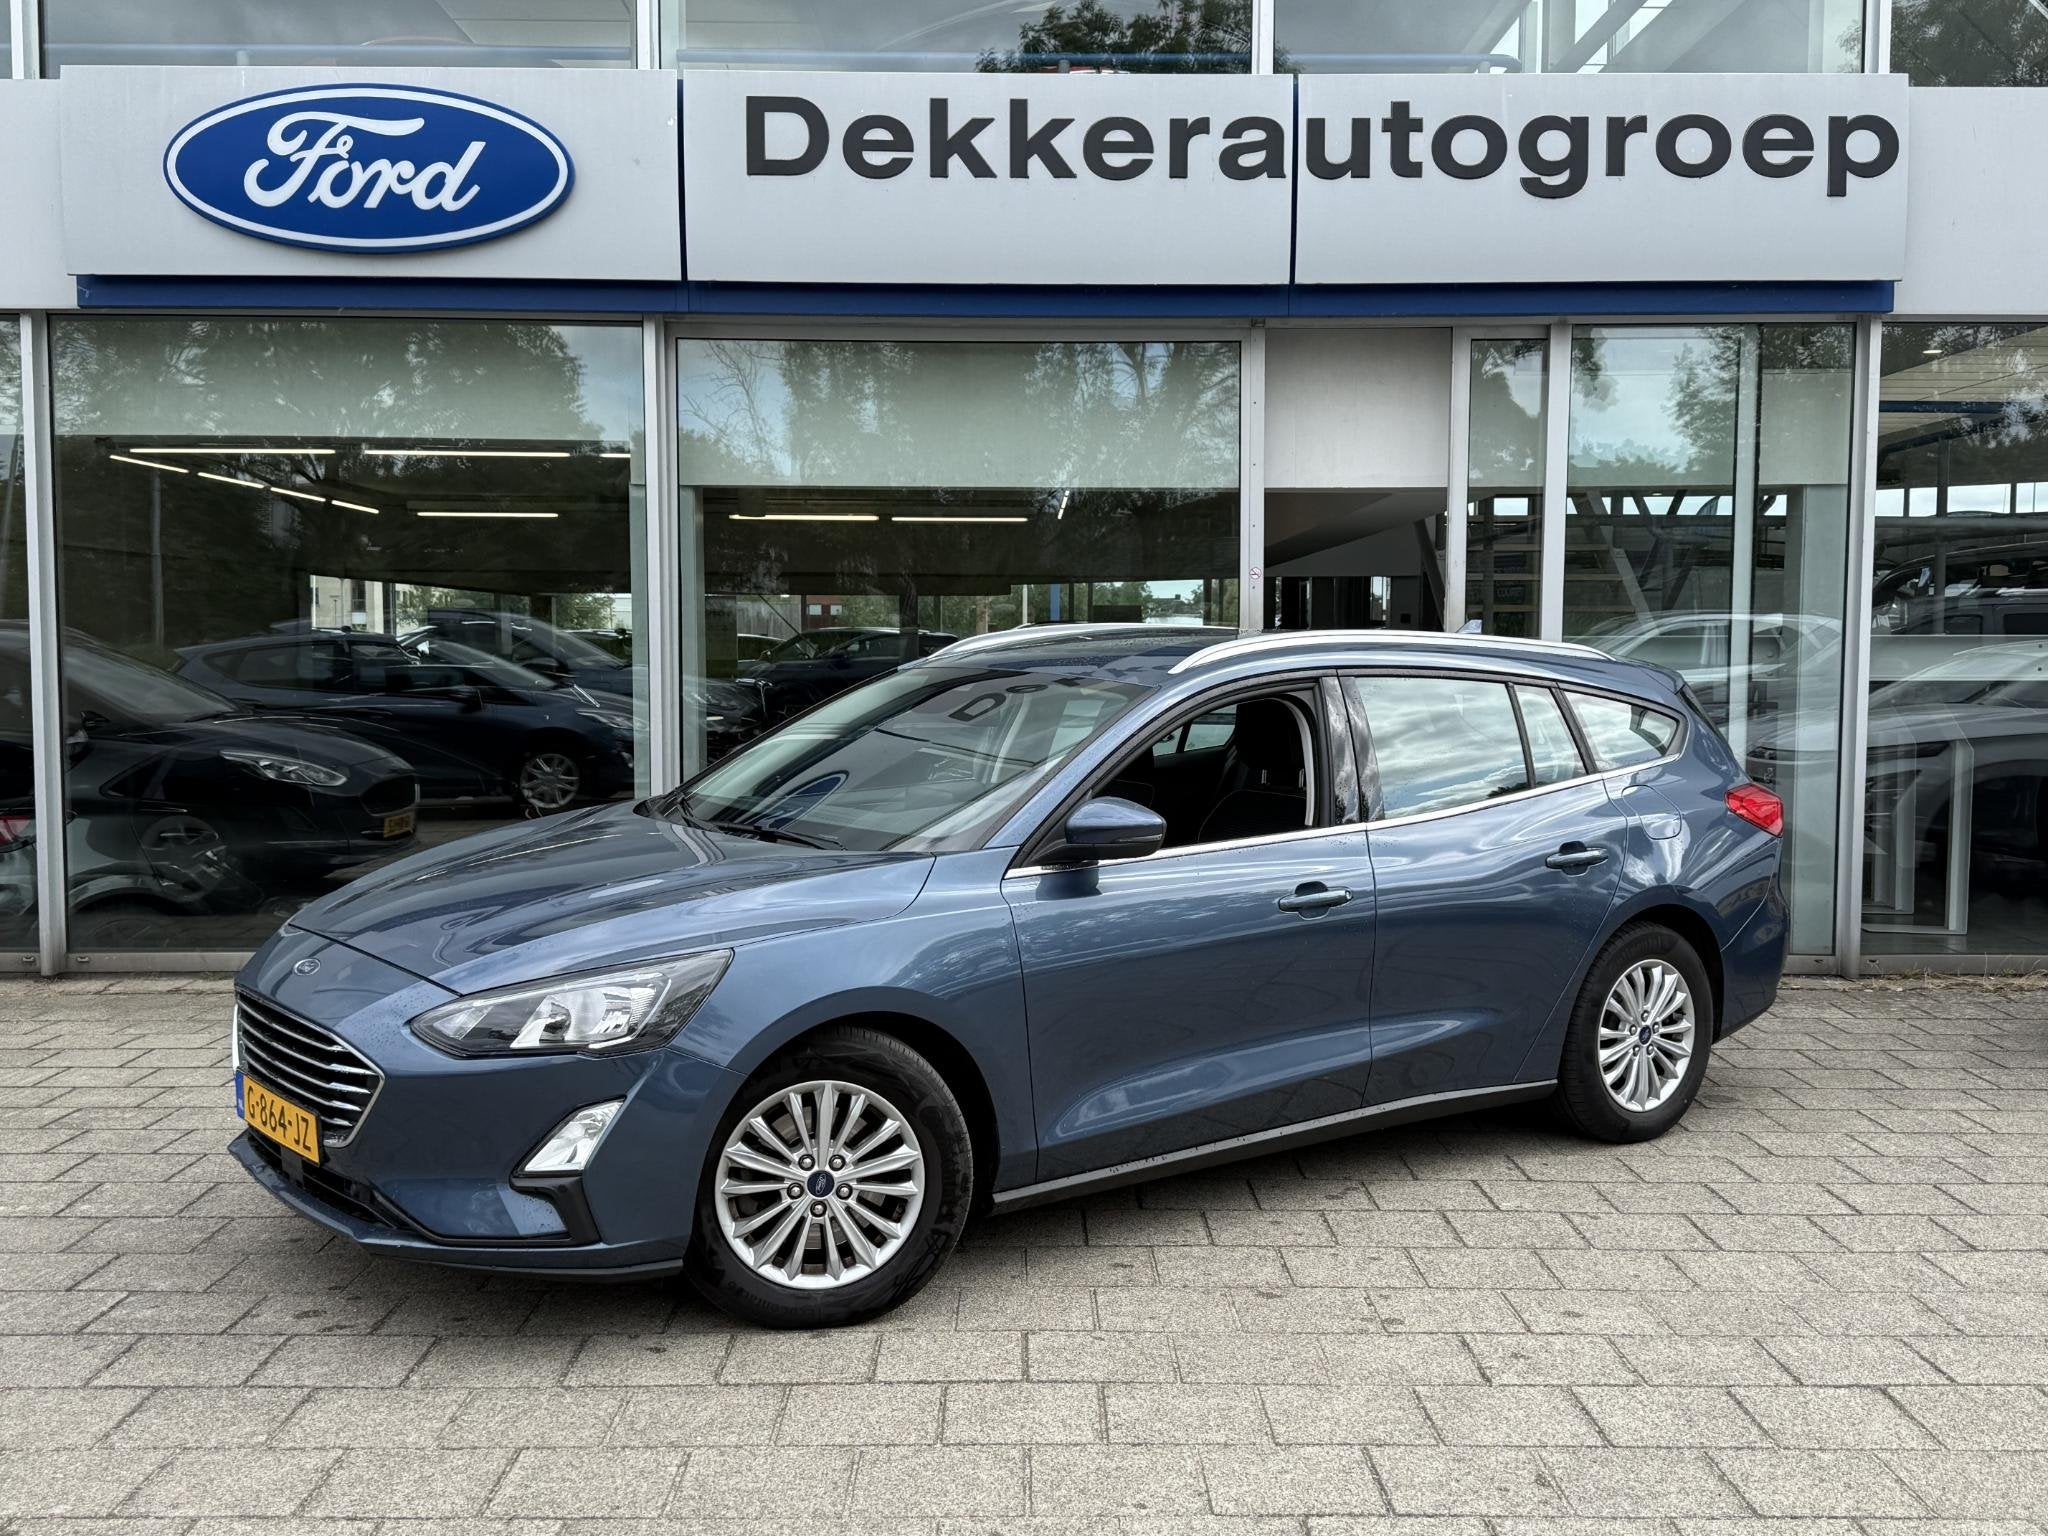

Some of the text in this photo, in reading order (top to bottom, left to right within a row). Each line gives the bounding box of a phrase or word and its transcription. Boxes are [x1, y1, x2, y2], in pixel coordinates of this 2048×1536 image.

[244, 111, 487, 211] Ford
[746, 95, 1900, 199] Dekkerautogroep
[247, 1085, 312, 1152] G-864-JZ
